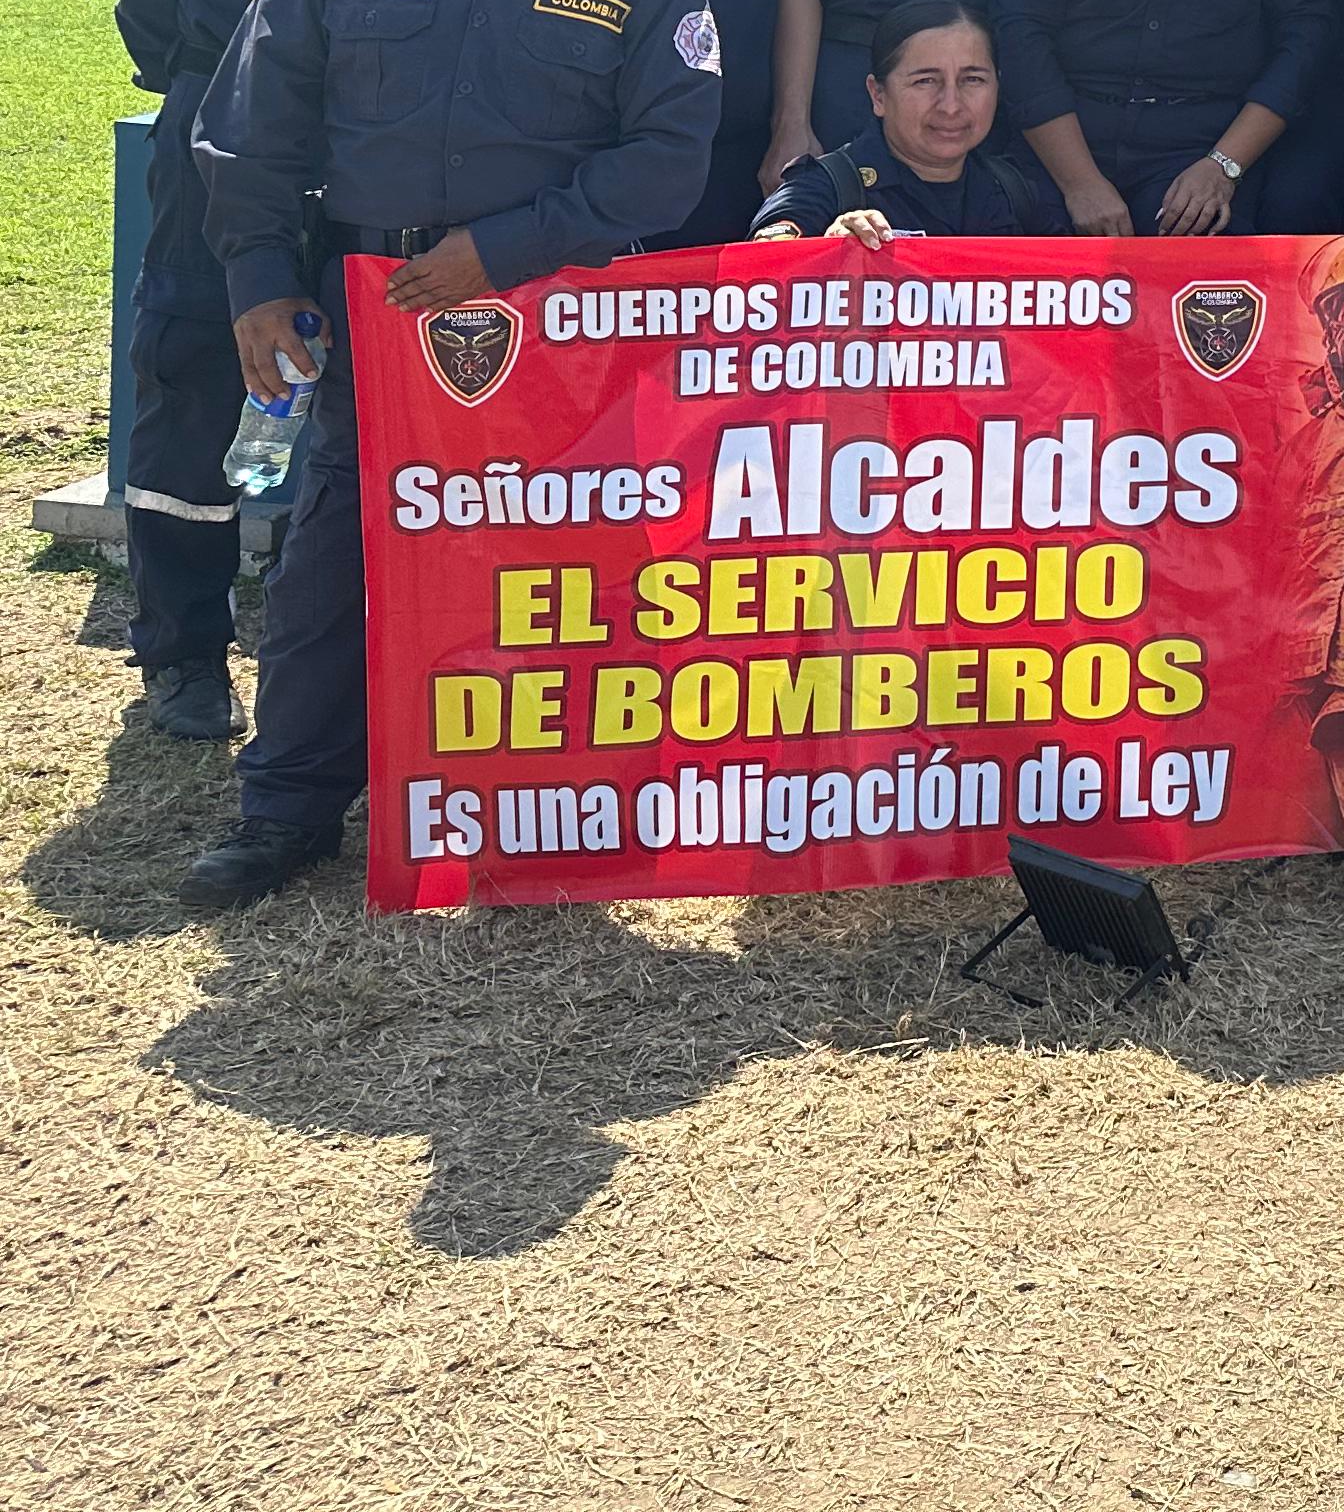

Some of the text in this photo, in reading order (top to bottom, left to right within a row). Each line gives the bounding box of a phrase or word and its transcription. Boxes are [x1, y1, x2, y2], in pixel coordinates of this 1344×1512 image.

[444, 310, 497, 321] BOMBEROS
[544, 279, 1132, 342] CUERPOS DE BOMBEROS
[680, 340, 1006, 396] DE COLOMBIA
[395, 418, 1238, 540] Señores Alcaldes
[501, 545, 1142, 645] EL SERVICIO
[435, 641, 1203, 752] DE BOMBEROS
[408, 741, 1230, 859] Es una obligación de Ley
